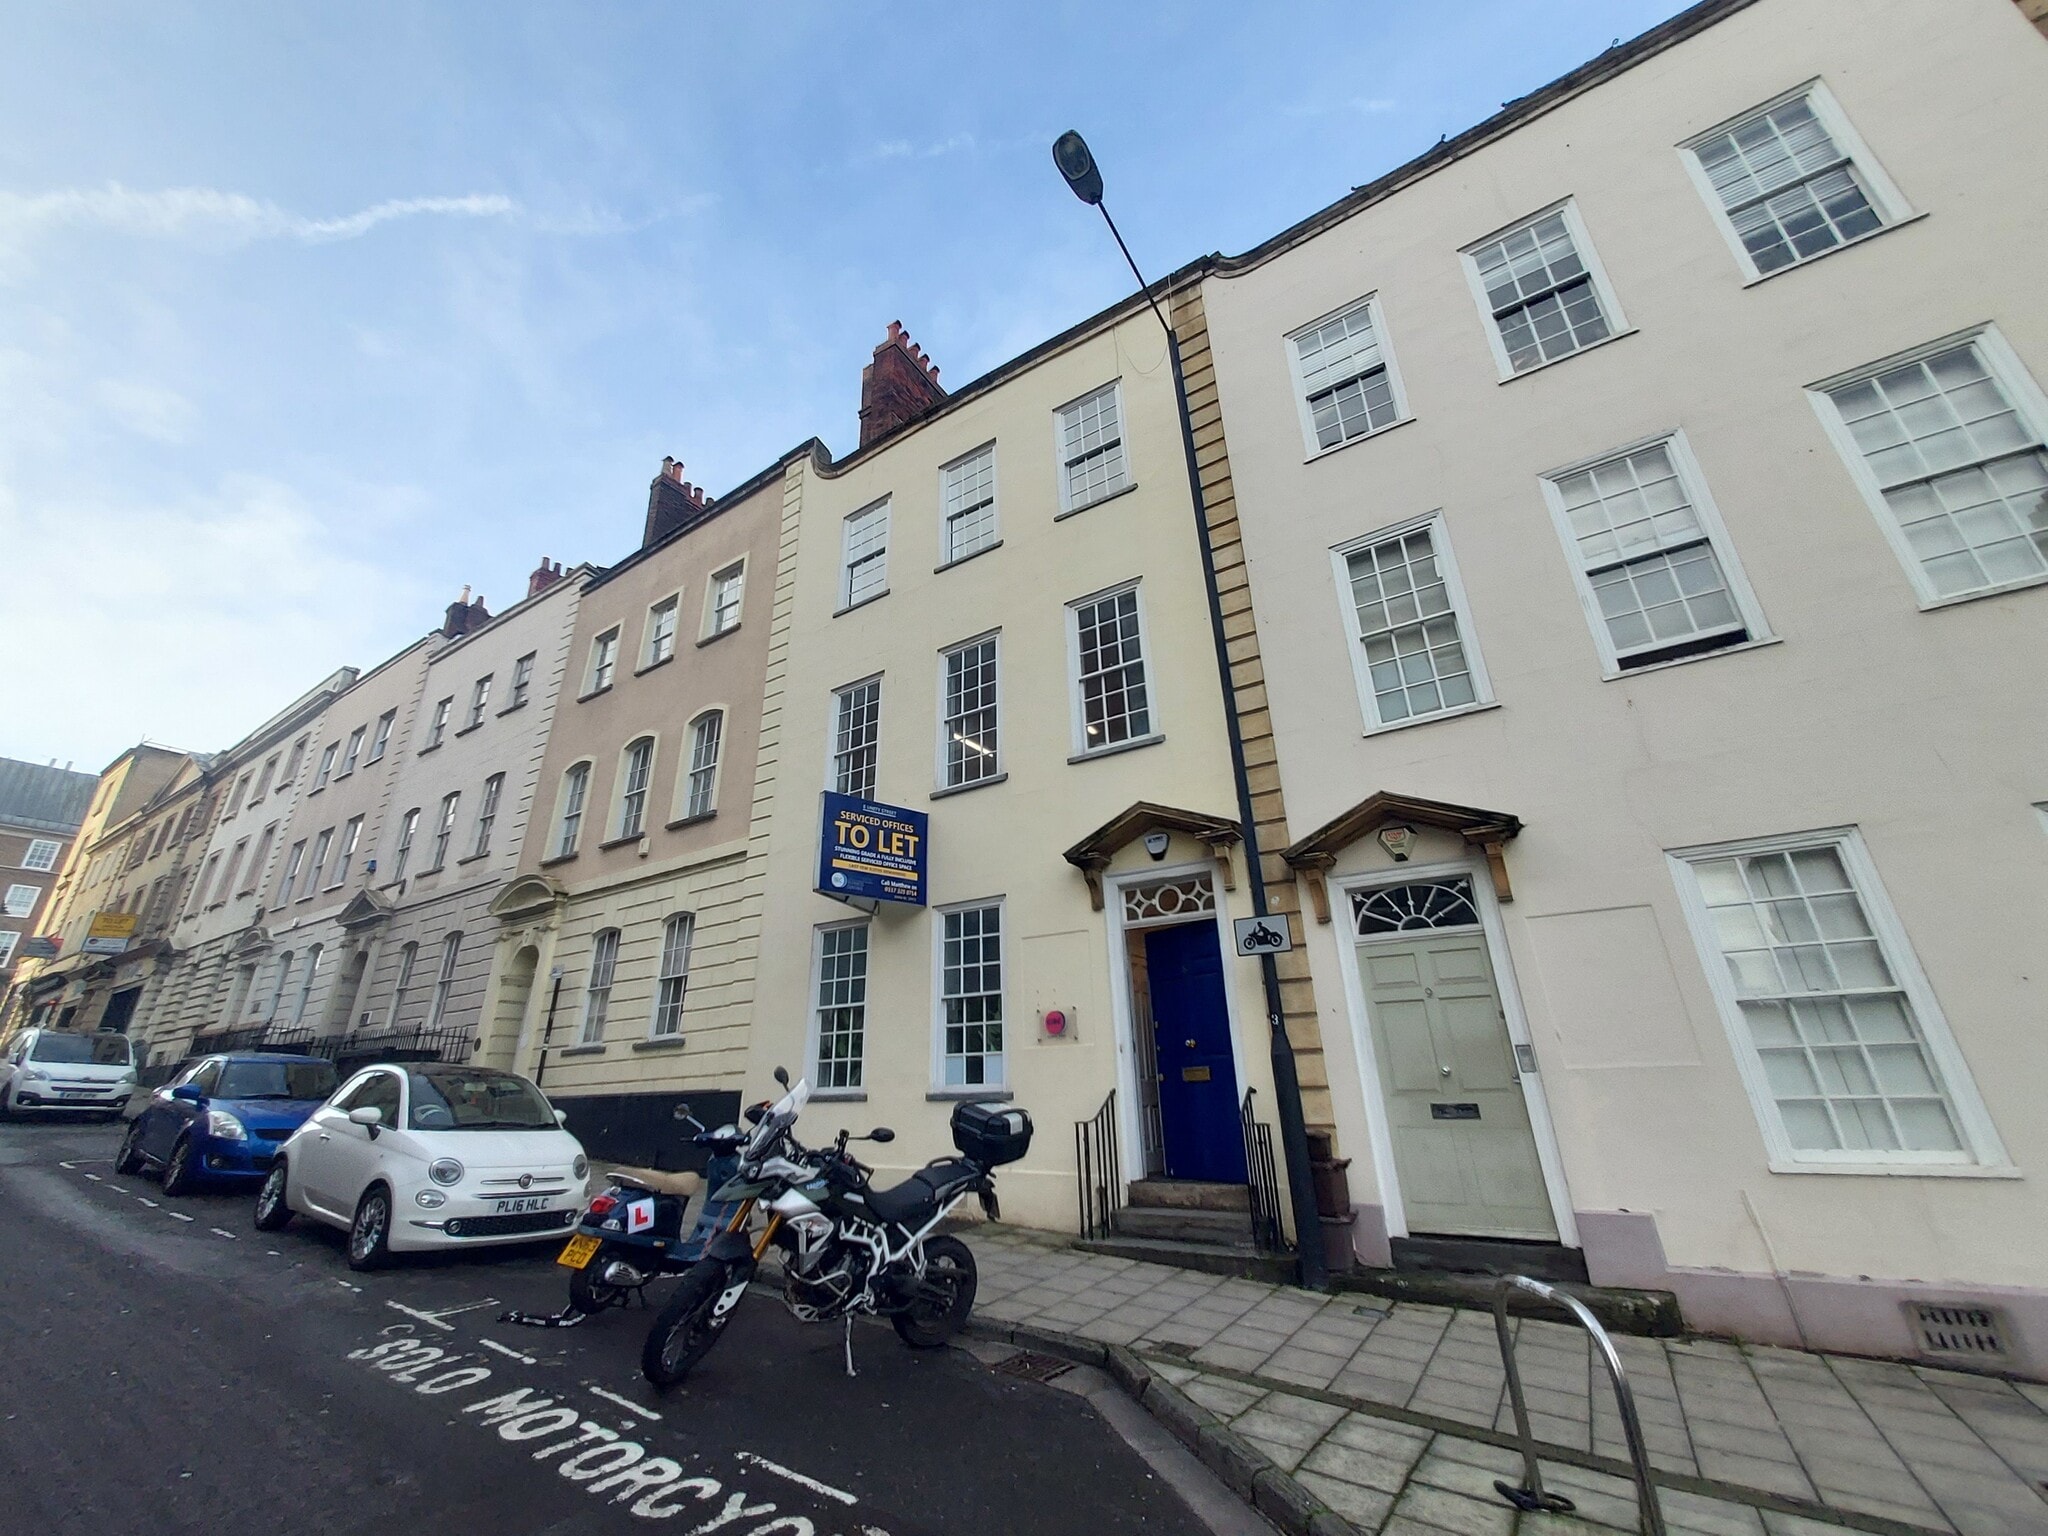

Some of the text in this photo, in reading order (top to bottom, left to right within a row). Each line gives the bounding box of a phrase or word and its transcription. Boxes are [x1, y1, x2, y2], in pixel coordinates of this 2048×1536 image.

[840, 811, 914, 833] SERVICED OFFICES
[834, 820, 919, 858] TO LET
[834, 845, 860, 855] STUNNING
[839, 853, 860, 862] FLEXIBLE
[860, 857, 882, 866] SERVICED
[882, 861, 898, 869] OFFICE
[890, 881, 911, 889] Matthew
[1271, 1013, 1279, 1025] 3
[496, 1198, 550, 1213] PL16 HLC
[634, 1207, 649, 1226] L
[347, 1338, 491, 1394] SOLO
